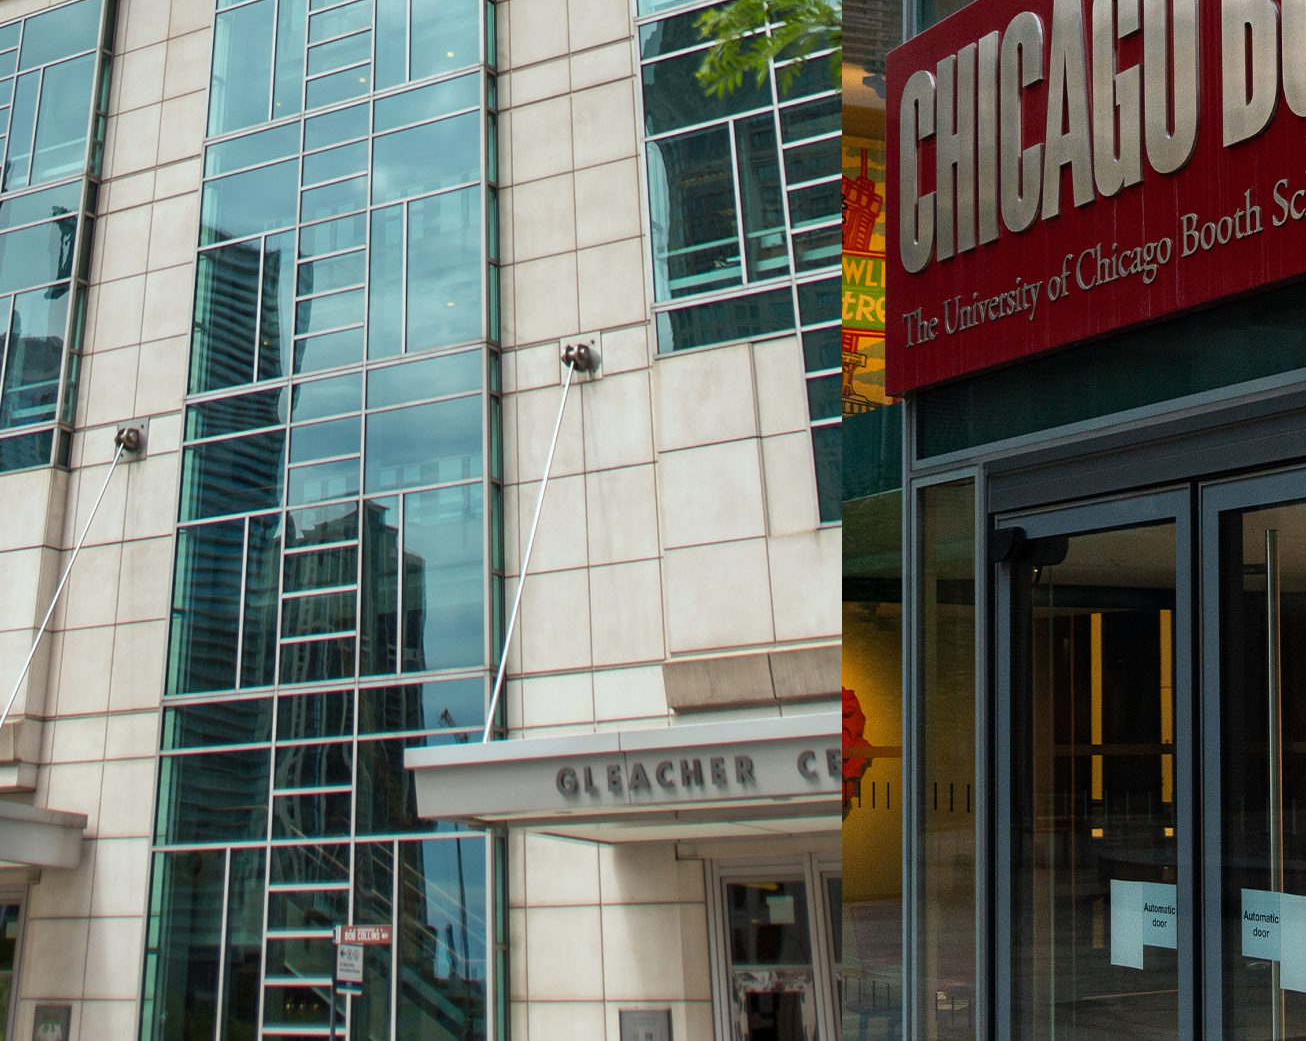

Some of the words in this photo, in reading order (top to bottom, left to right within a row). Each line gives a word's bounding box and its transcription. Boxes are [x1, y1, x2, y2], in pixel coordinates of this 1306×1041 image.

[901, 306, 939, 348] The
[943, 276, 1044, 335] University
[1047, 253, 1075, 301] of
[1075, 236, 1173, 291] Chicago
[1180, 188, 1264, 258] Booth
[555, 755, 756, 797] GLEACHER
[1143, 902, 1176, 915] Automatic
[1152, 917, 1168, 928] door
[1243, 910, 1279, 924] Automatic
[1253, 927, 1270, 938] door
